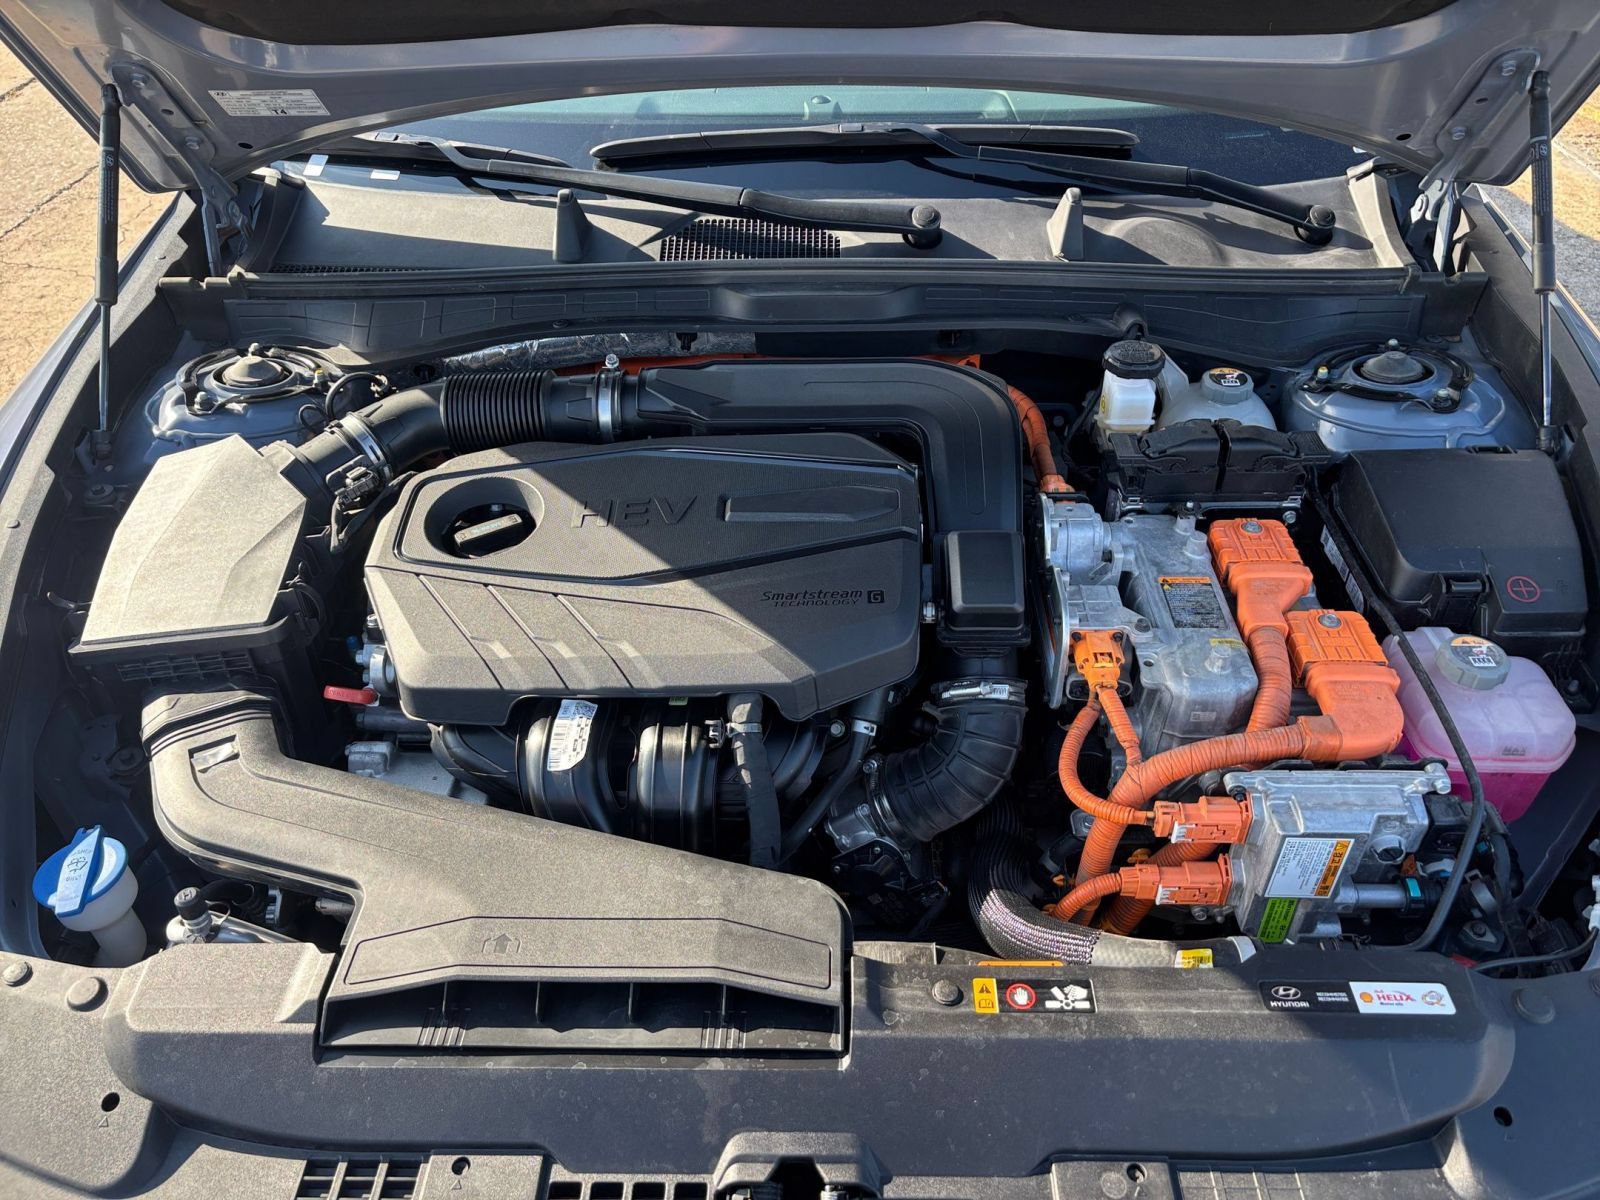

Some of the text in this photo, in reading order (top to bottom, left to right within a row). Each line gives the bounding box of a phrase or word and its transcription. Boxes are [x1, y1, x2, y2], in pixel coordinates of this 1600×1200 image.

[571, 494, 698, 529] HEV
[761, 588, 863, 601] Smartstream
[774, 599, 860, 608] TECHNOLOGY
[1376, 993, 1414, 1002] HELIX
[1269, 1000, 1311, 1008] HYUNDAI
